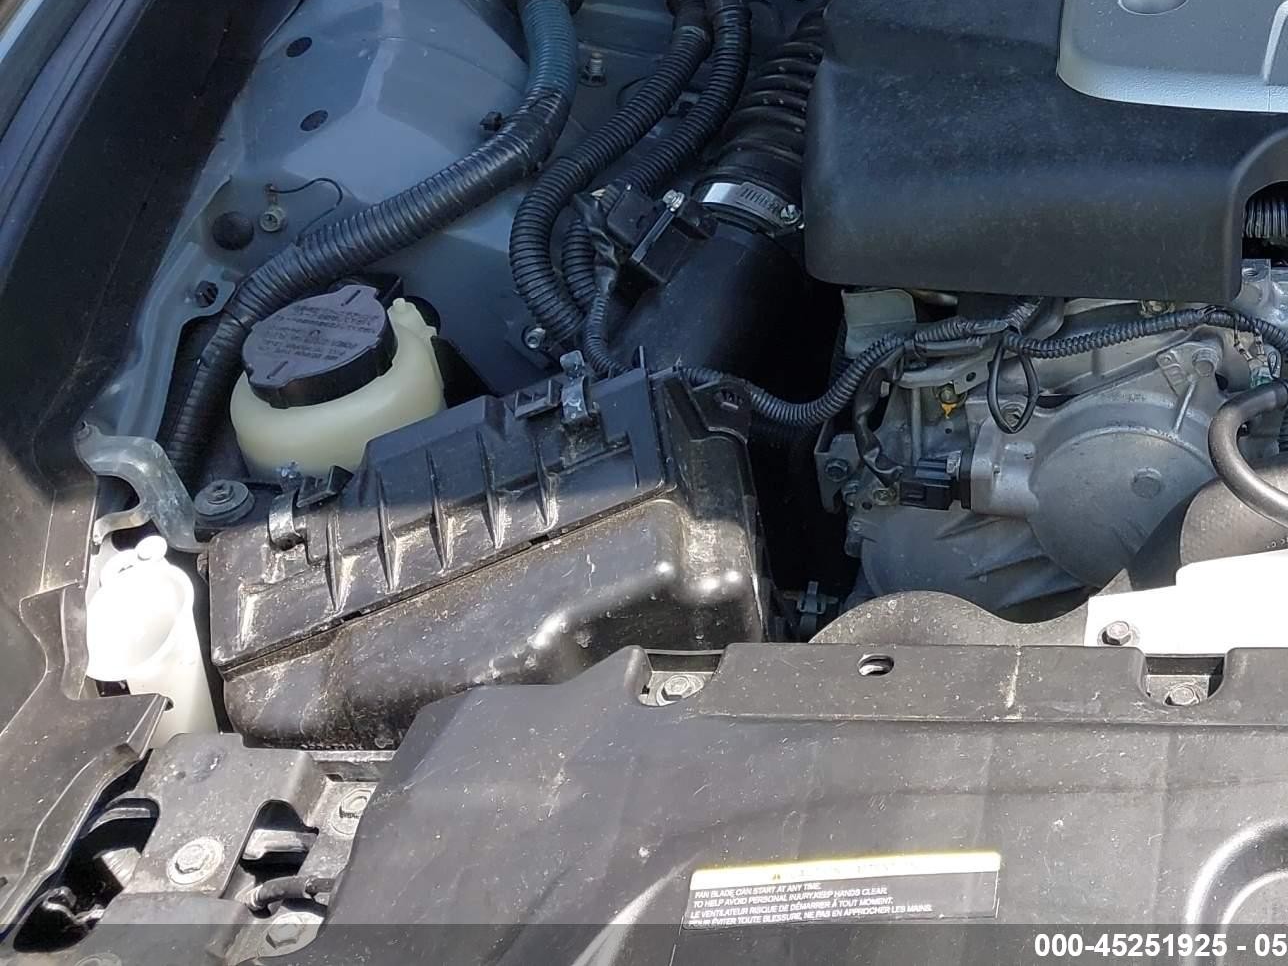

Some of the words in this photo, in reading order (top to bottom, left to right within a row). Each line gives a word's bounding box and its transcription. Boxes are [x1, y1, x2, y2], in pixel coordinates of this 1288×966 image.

[693, 900, 704, 908] TO
[704, 899, 724, 908] HELP
[724, 897, 747, 907] AVOID
[748, 895, 788, 905] PERSONAL
[834, 889, 860, 898] HANDS
[694, 891, 710, 899] FAN
[711, 889, 736, 898] BLADE
[736, 888, 752, 896] CAN
[752, 886, 776, 895] START
[776, 885, 787, 893] AT
[787, 884, 803, 892] ANY
[690, 911, 700, 919] LE
[701, 907, 749, 918] VENTILATEUR
[778, 905, 789, 913] DE
[838, 898, 858, 908] TOUT
[737, 915, 762, 924] TOUTE
[803, 911, 815, 919] NE
[831, 909, 843, 917] EN
[843, 906, 891, 917] APPROCHER
